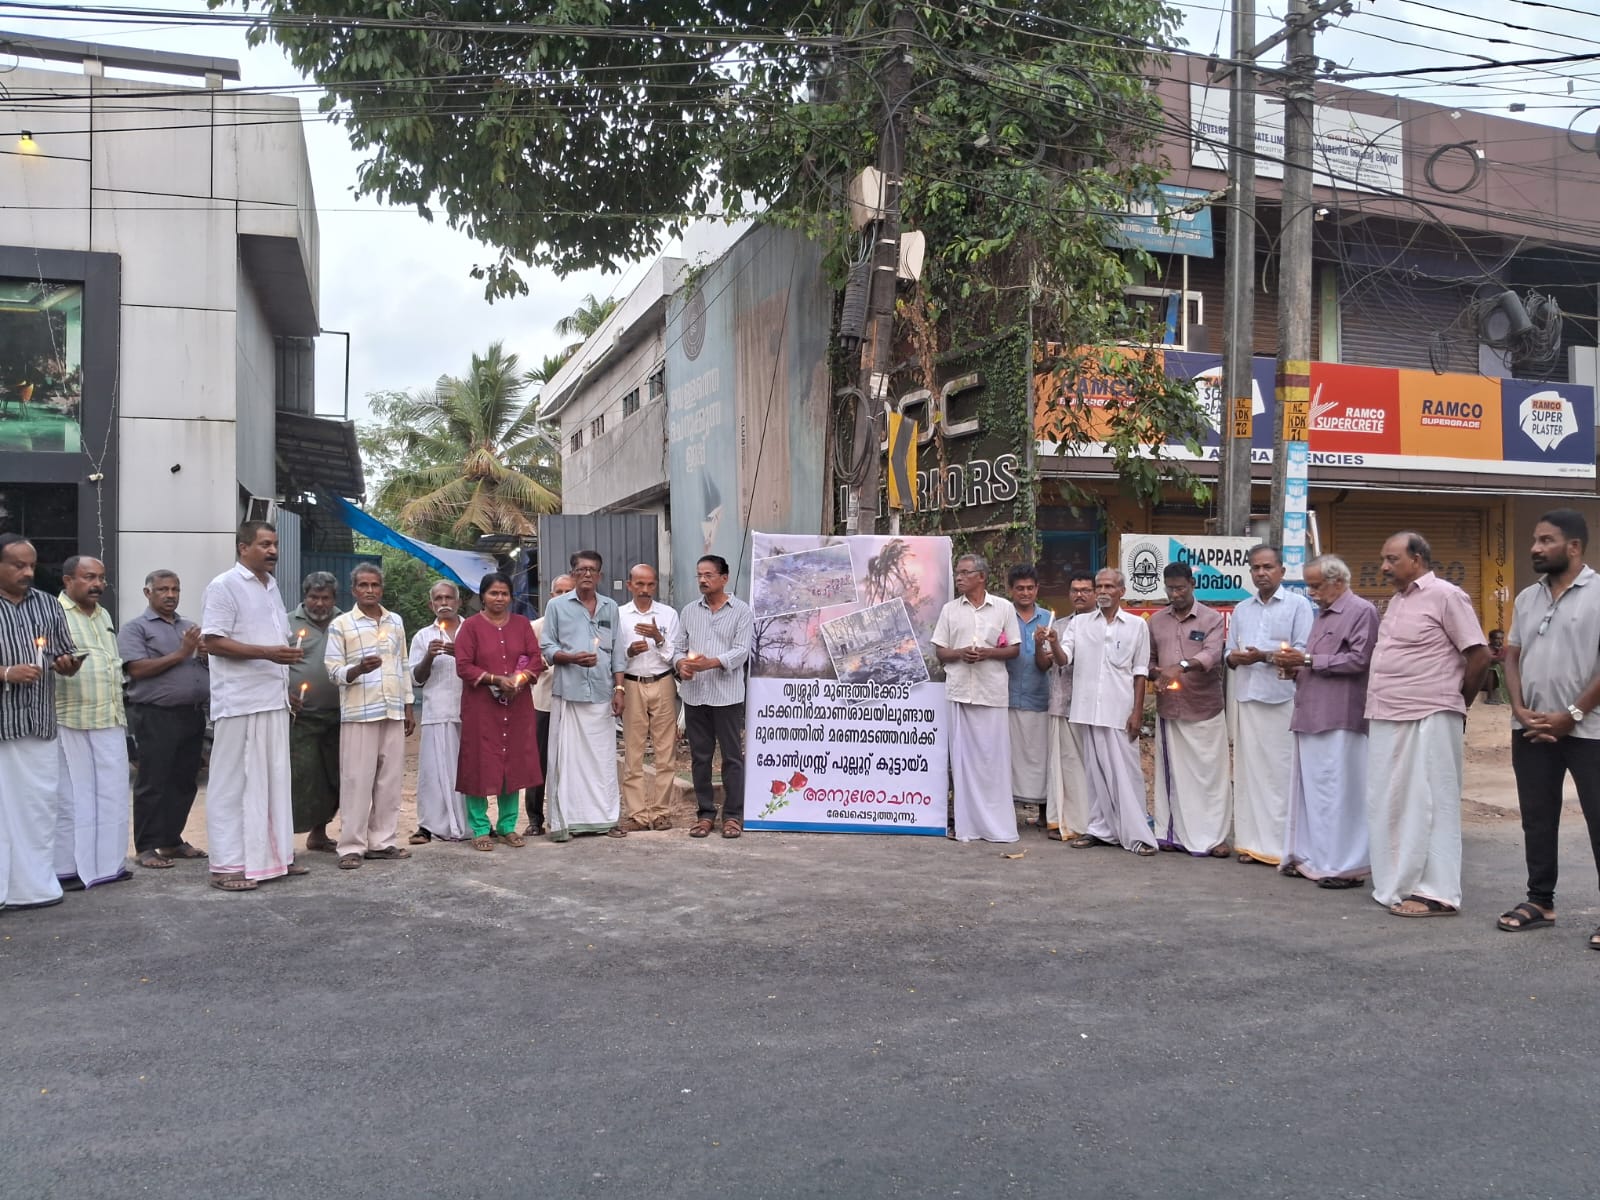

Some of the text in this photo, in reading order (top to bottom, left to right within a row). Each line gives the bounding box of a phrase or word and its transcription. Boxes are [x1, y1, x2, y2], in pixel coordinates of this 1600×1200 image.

[1198, 122, 1229, 136] DEVELOP
[1421, 399, 1483, 419] RAMCO
[1532, 400, 1562, 410] RAMCO
[1345, 407, 1385, 419] RAMCO
[1531, 409, 1563, 423] SUPER
[1316, 416, 1385, 432] SUPERCRETE
[1421, 417, 1481, 429] SUPERGRADE
[1531, 422, 1564, 437] PLASTER
[1307, 452, 1364, 466] ENCIES
[839, 454, 1019, 523] IRIORS
[755, 723, 938, 746] ദുരന്തത്തിൽ മരണമടഞ്ഞവർക്ക്
[803, 787, 932, 807] അനുശോചനം
